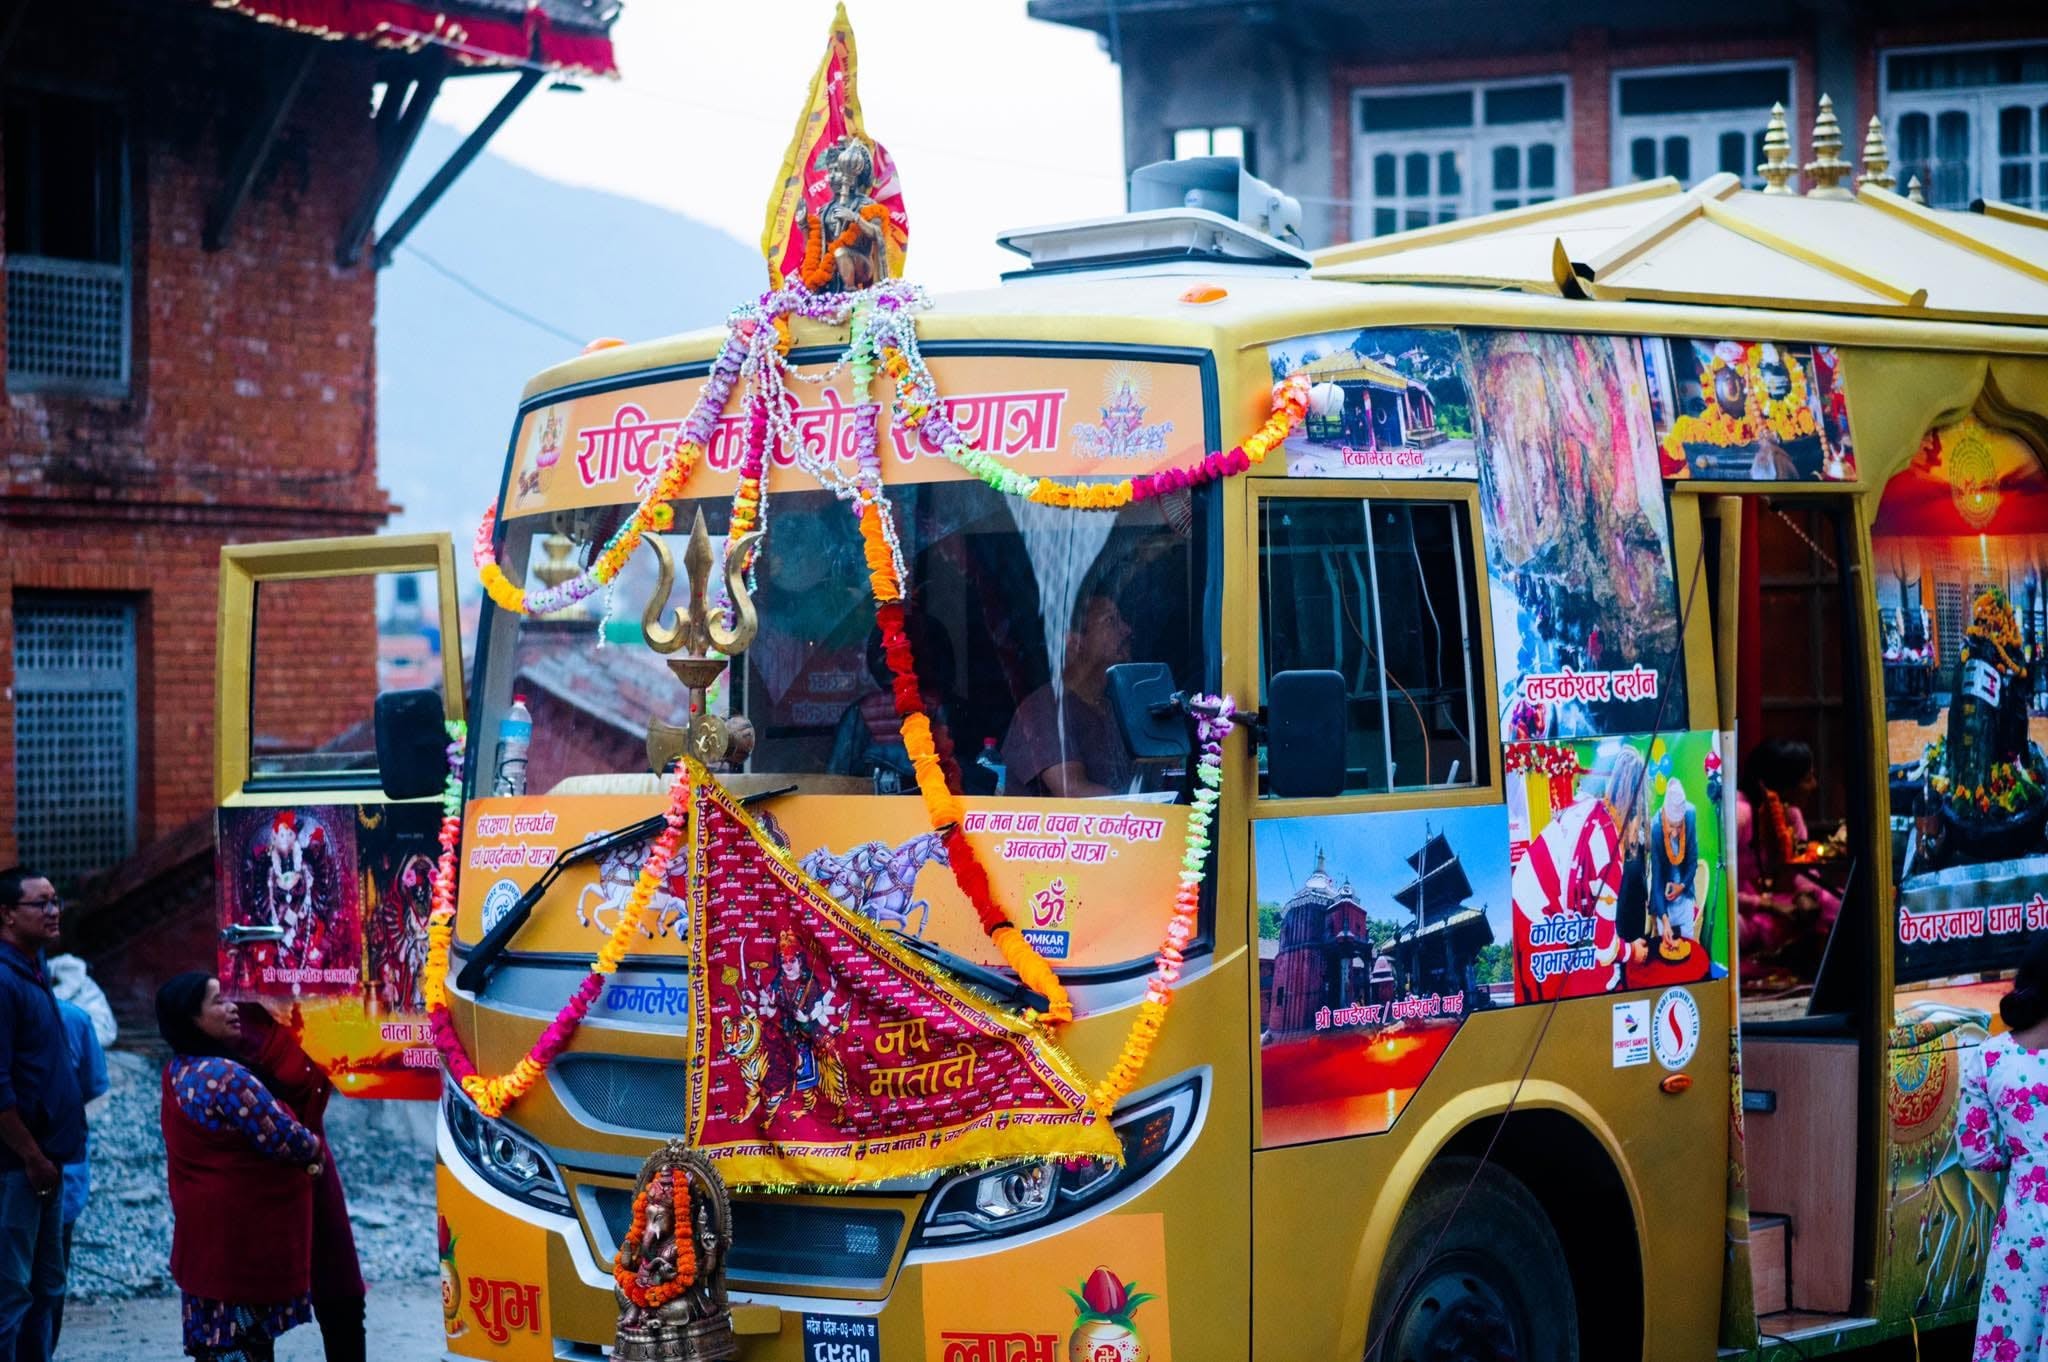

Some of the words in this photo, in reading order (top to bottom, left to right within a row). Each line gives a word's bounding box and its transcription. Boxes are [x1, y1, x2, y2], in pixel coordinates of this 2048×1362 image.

[1397, 448, 1423, 466] दर्शन
[1613, 666, 1656, 698] दर्शन
[964, 813, 985, 832] तन
[990, 813, 1011, 832] मन
[1083, 817, 1096, 835] र
[1004, 837, 1067, 861] अनन्तको
[1071, 843, 1108, 863] यात्रा
[1025, 934, 1064, 946] OMKAR
[1531, 913, 1597, 945] कोटिहोम
[1901, 909, 1983, 942] केदारनाथ
[1531, 948, 1597, 980] शुभारम्भ
[875, 1017, 931, 1056] जय
[869, 1042, 978, 1100] मातादी
[1013, 1112, 1033, 1126] जय
[467, 1276, 541, 1344] शुभ
